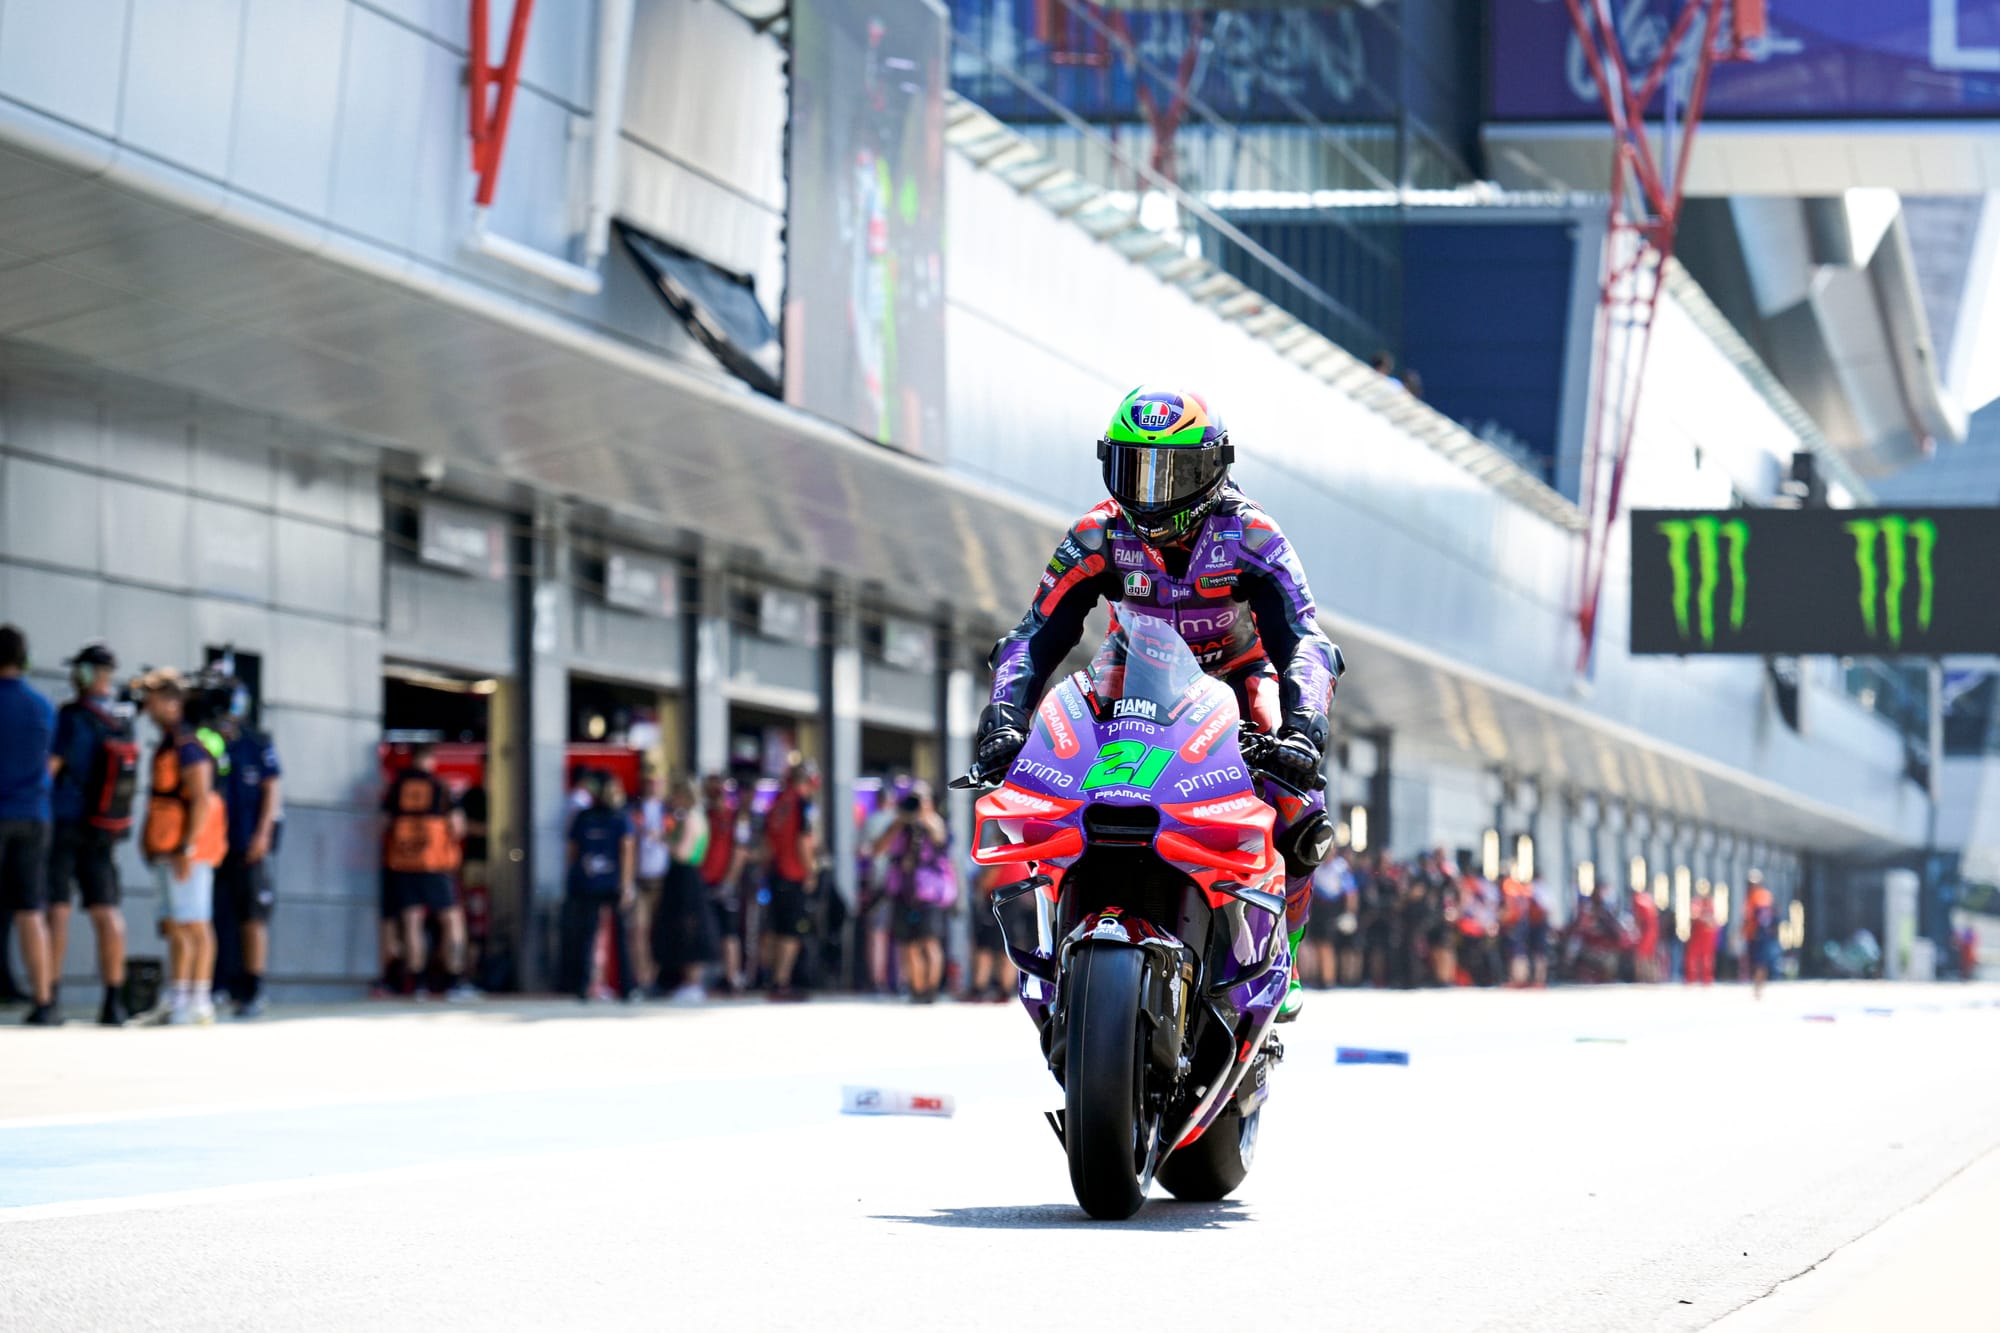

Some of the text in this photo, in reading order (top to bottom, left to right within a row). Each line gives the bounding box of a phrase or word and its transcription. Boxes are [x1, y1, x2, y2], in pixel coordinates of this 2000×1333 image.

[994, 660, 1011, 699] prima
[1113, 699, 1157, 720] FIAMM
[1044, 703, 1073, 750] PRAMAC
[1107, 720, 1155, 736] prima
[1189, 709, 1233, 753] PRAMAC
[1013, 758, 1074, 788] prima
[1078, 739, 1177, 791] 21
[1095, 790, 1151, 801] PRAMAC
[1174, 766, 1242, 797] prima
[1000, 789, 1053, 811] MOTUL
[1193, 799, 1252, 818] MOTUL
